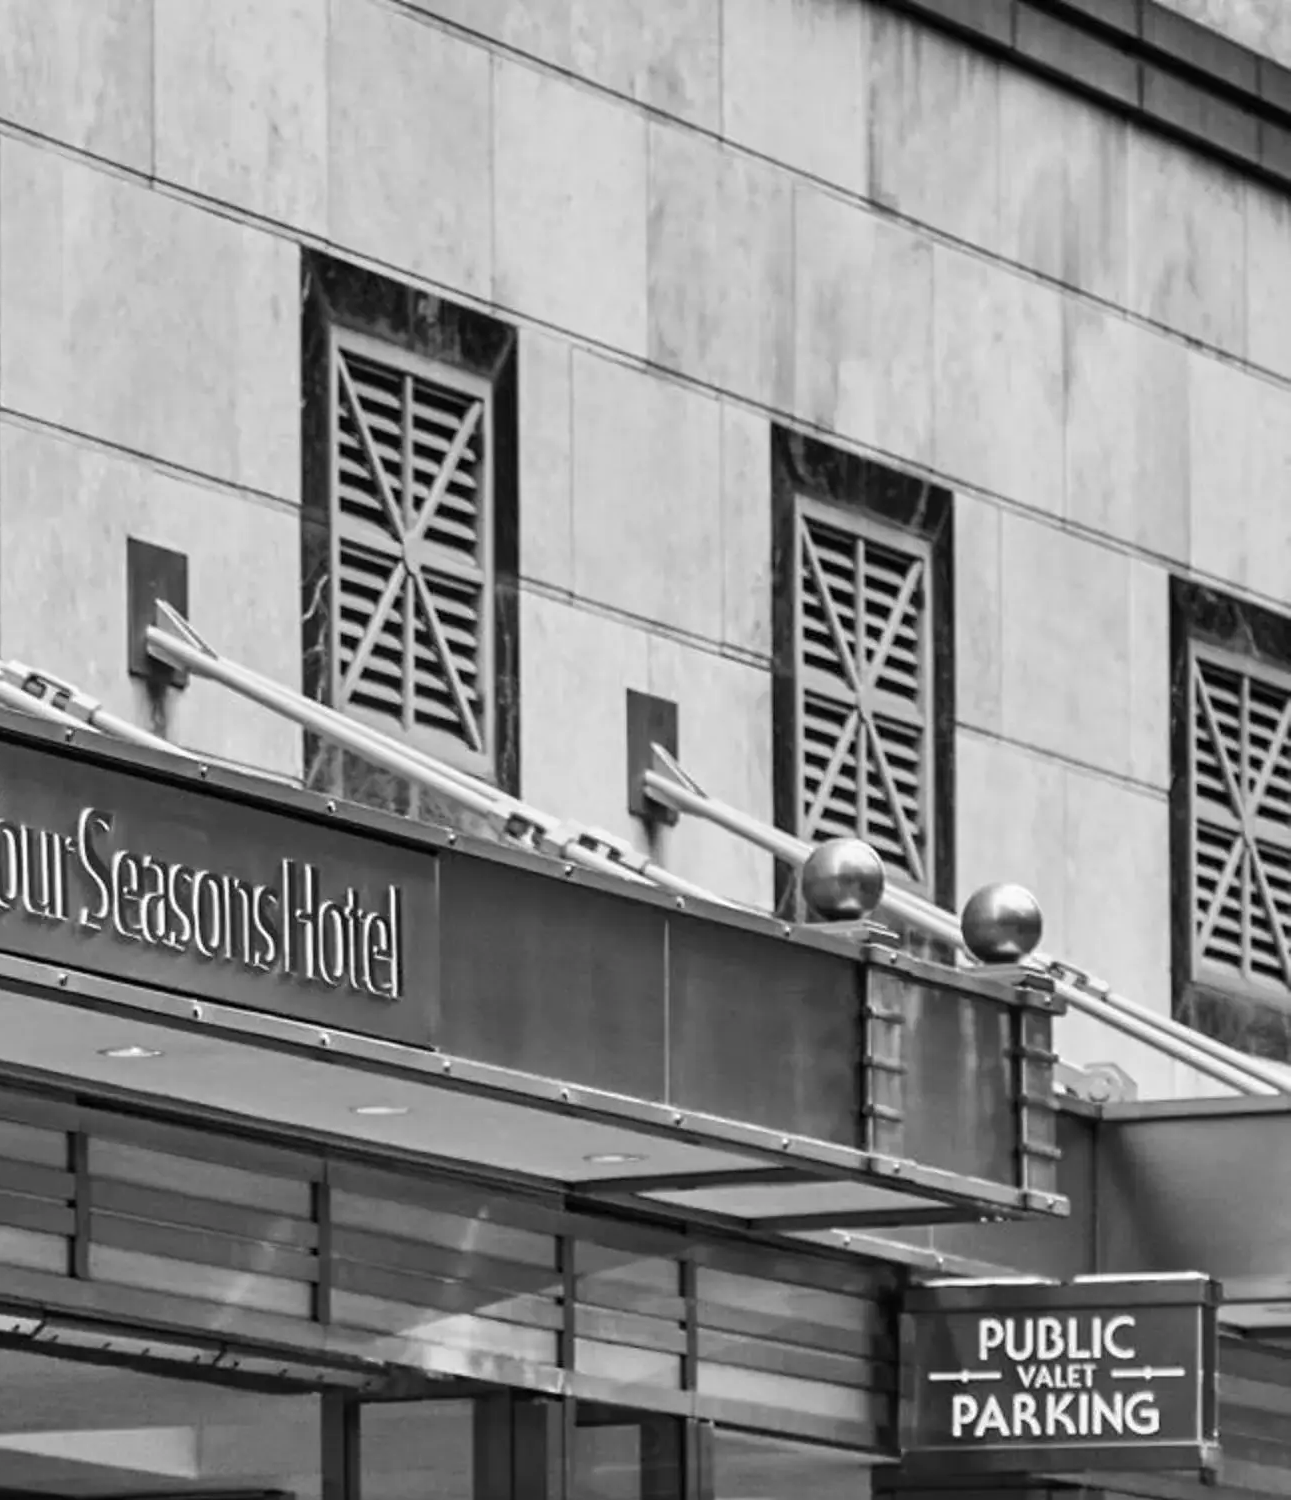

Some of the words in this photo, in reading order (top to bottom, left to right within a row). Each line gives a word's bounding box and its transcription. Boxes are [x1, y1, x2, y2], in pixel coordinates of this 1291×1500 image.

[78, 807, 277, 970] Seasons
[281, 857, 402, 1000] Hotel
[979, 1315, 1136, 1361] PUBLIC
[1016, 1364, 1097, 1389] VALET
[952, 1391, 1160, 1438] PARKING
